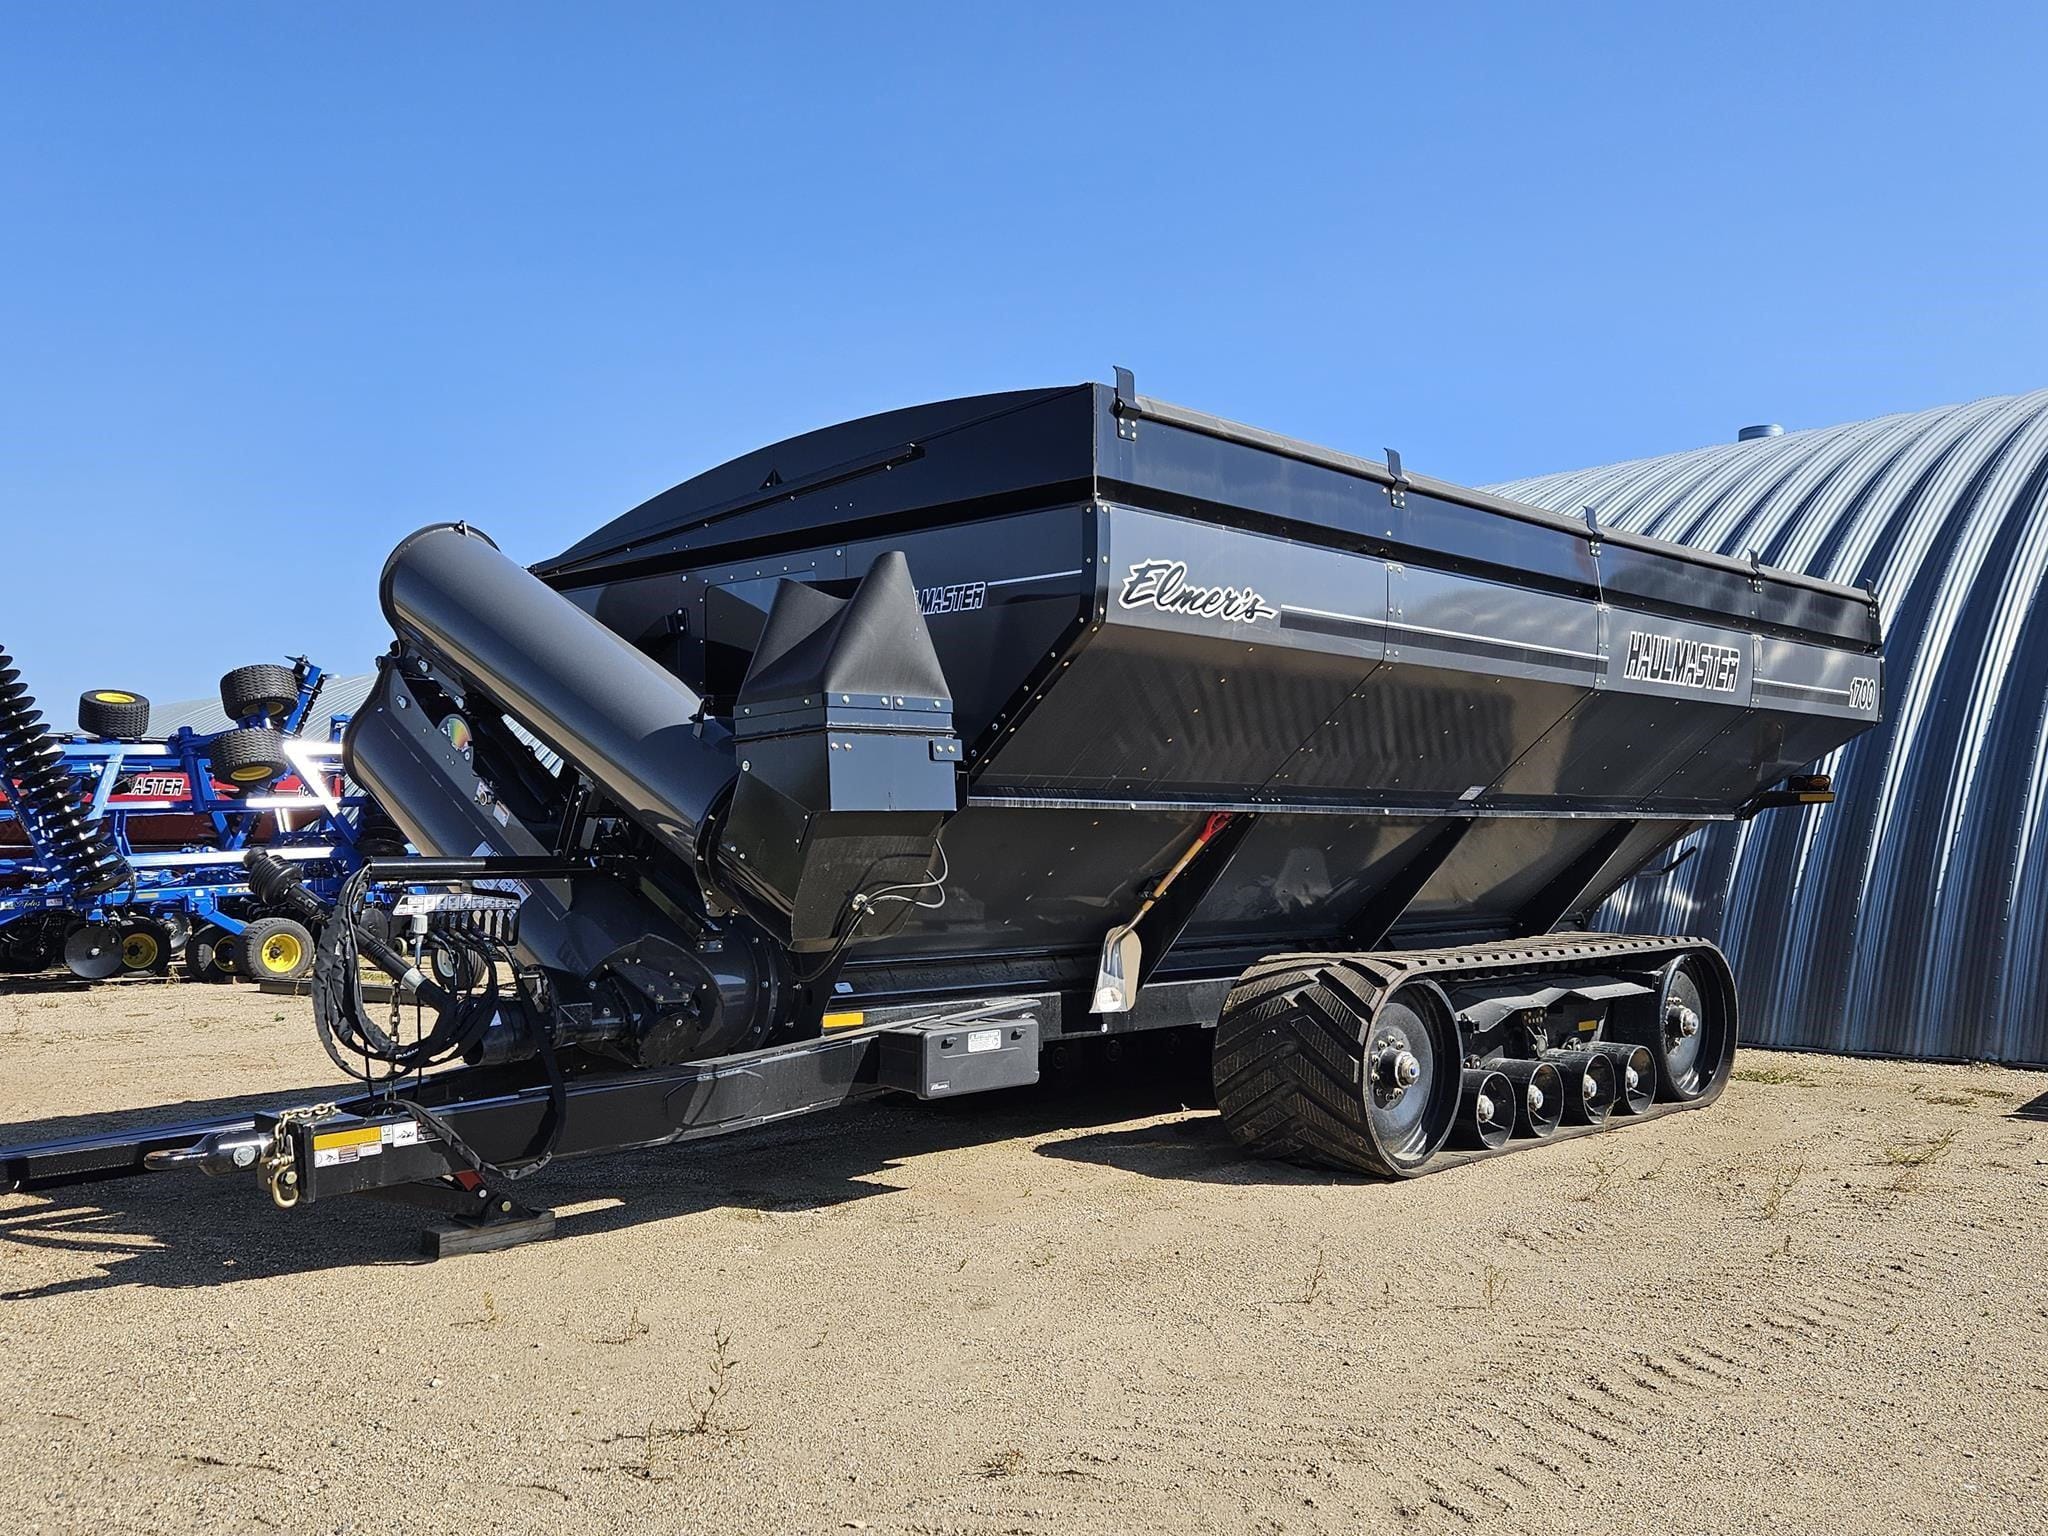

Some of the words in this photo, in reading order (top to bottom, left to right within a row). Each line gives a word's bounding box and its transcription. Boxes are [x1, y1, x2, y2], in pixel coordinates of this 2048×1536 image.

[915, 582, 986, 615] MASTER
[1118, 558, 1279, 623] Elmer's
[1623, 631, 1740, 692] HAULMASTER
[1849, 677, 1876, 711] 1700
[131, 777, 184, 796] ASTER
